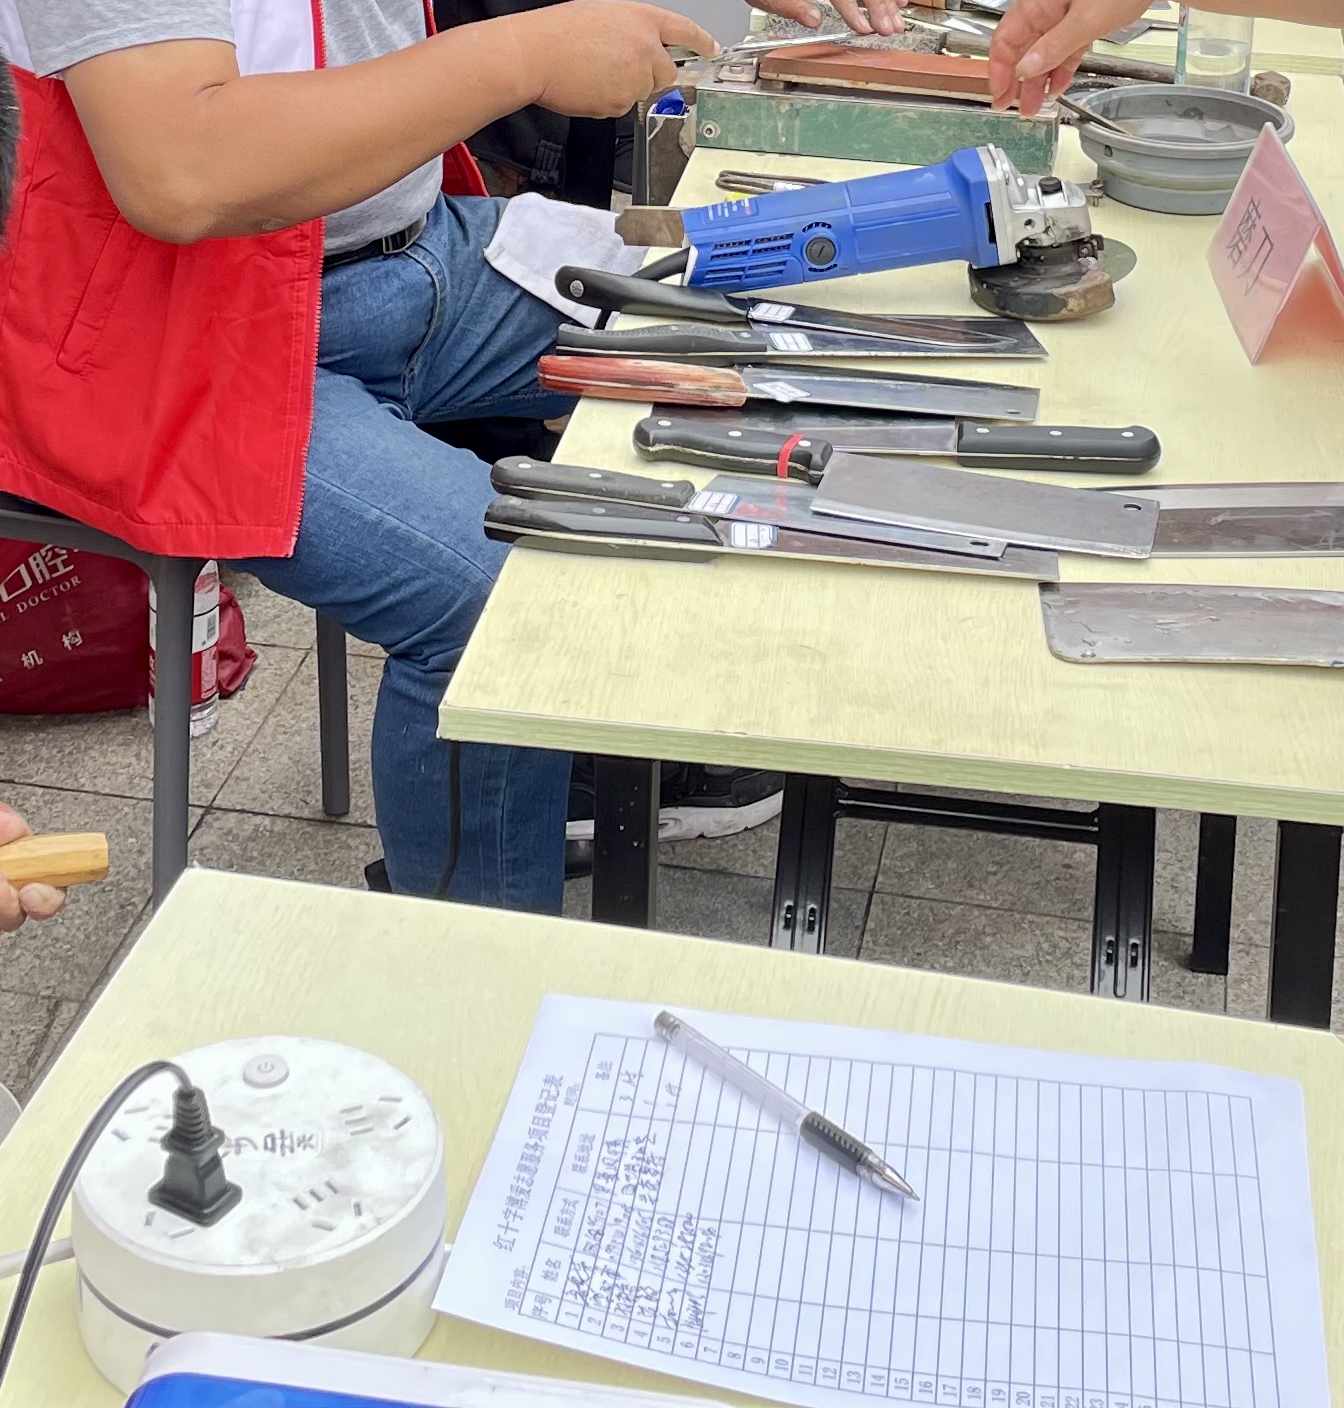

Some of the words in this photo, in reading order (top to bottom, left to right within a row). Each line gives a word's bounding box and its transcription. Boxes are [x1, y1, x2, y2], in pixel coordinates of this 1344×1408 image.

[16, 575, 82, 614] DOCTOR
[487, 1072, 569, 1252] 红十字博爱志愿服务项目登记表
[539, 1256, 563, 1281] 姓名
[529, 1294, 554, 1318] 序号
[775, 1358, 790, 1372] 10
[799, 1362, 813, 1378] 11
[823, 1366, 838, 1381] 12
[847, 1370, 862, 1385] 13
[870, 1372, 886, 1389] 14
[895, 1376, 910, 1392] 15
[918, 1379, 934, 1395] 16
[942, 1383, 958, 1399] 17
[966, 1385, 982, 1401] 18
[990, 1388, 1006, 1404] 19
